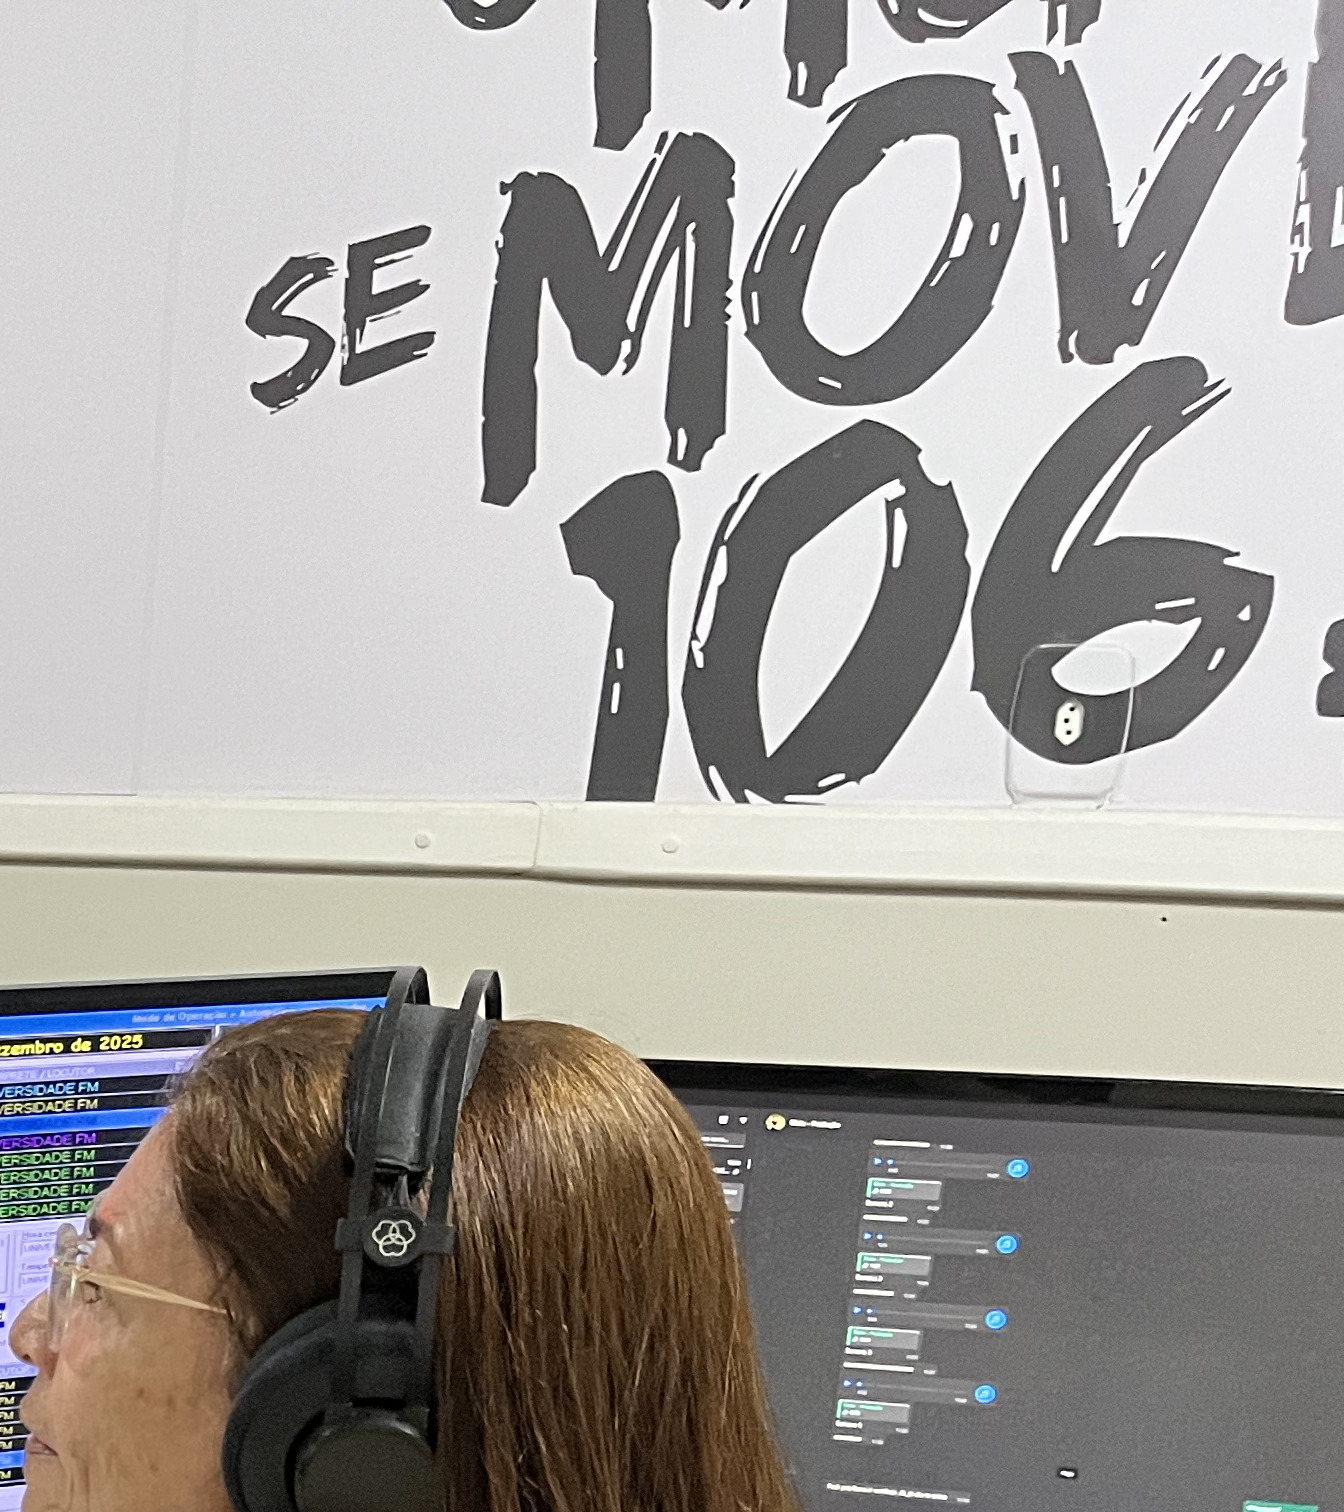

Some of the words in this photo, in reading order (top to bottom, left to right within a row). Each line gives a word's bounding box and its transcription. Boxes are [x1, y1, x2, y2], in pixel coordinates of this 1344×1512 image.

[245, 224, 436, 413] SE
[481, 51, 1344, 508] MOV
[70, 1039, 92, 1052] de
[100, 1034, 143, 1050] 2025
[78, 1081, 99, 1093] FM
[77, 1099, 98, 1111] FM
[76, 1132, 96, 1144] FM
